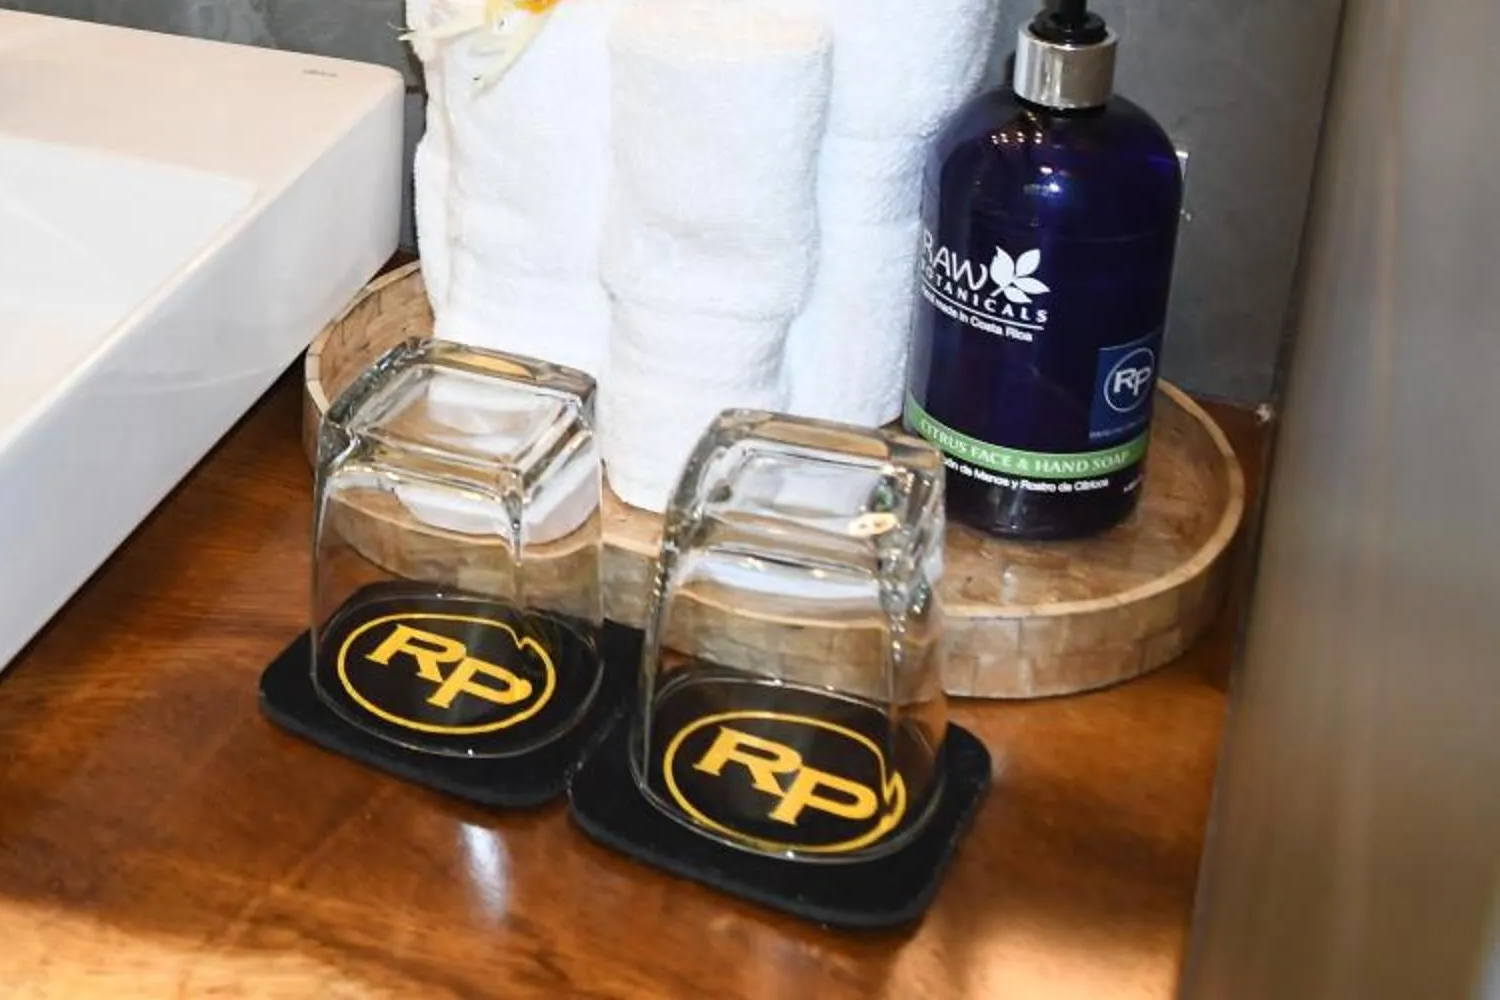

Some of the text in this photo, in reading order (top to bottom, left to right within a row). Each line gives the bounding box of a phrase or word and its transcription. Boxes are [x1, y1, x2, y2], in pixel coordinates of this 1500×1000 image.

[922, 228, 988, 292] RAW
[970, 315, 1004, 336] Costa
[1005, 326, 1034, 342] Rica
[1113, 367, 1152, 396] RP
[970, 445, 1013, 468] FACE
[1016, 459, 1029, 472] &
[1035, 460, 1089, 473] HAND
[366, 623, 533, 709] RP
[693, 726, 879, 826] RP
